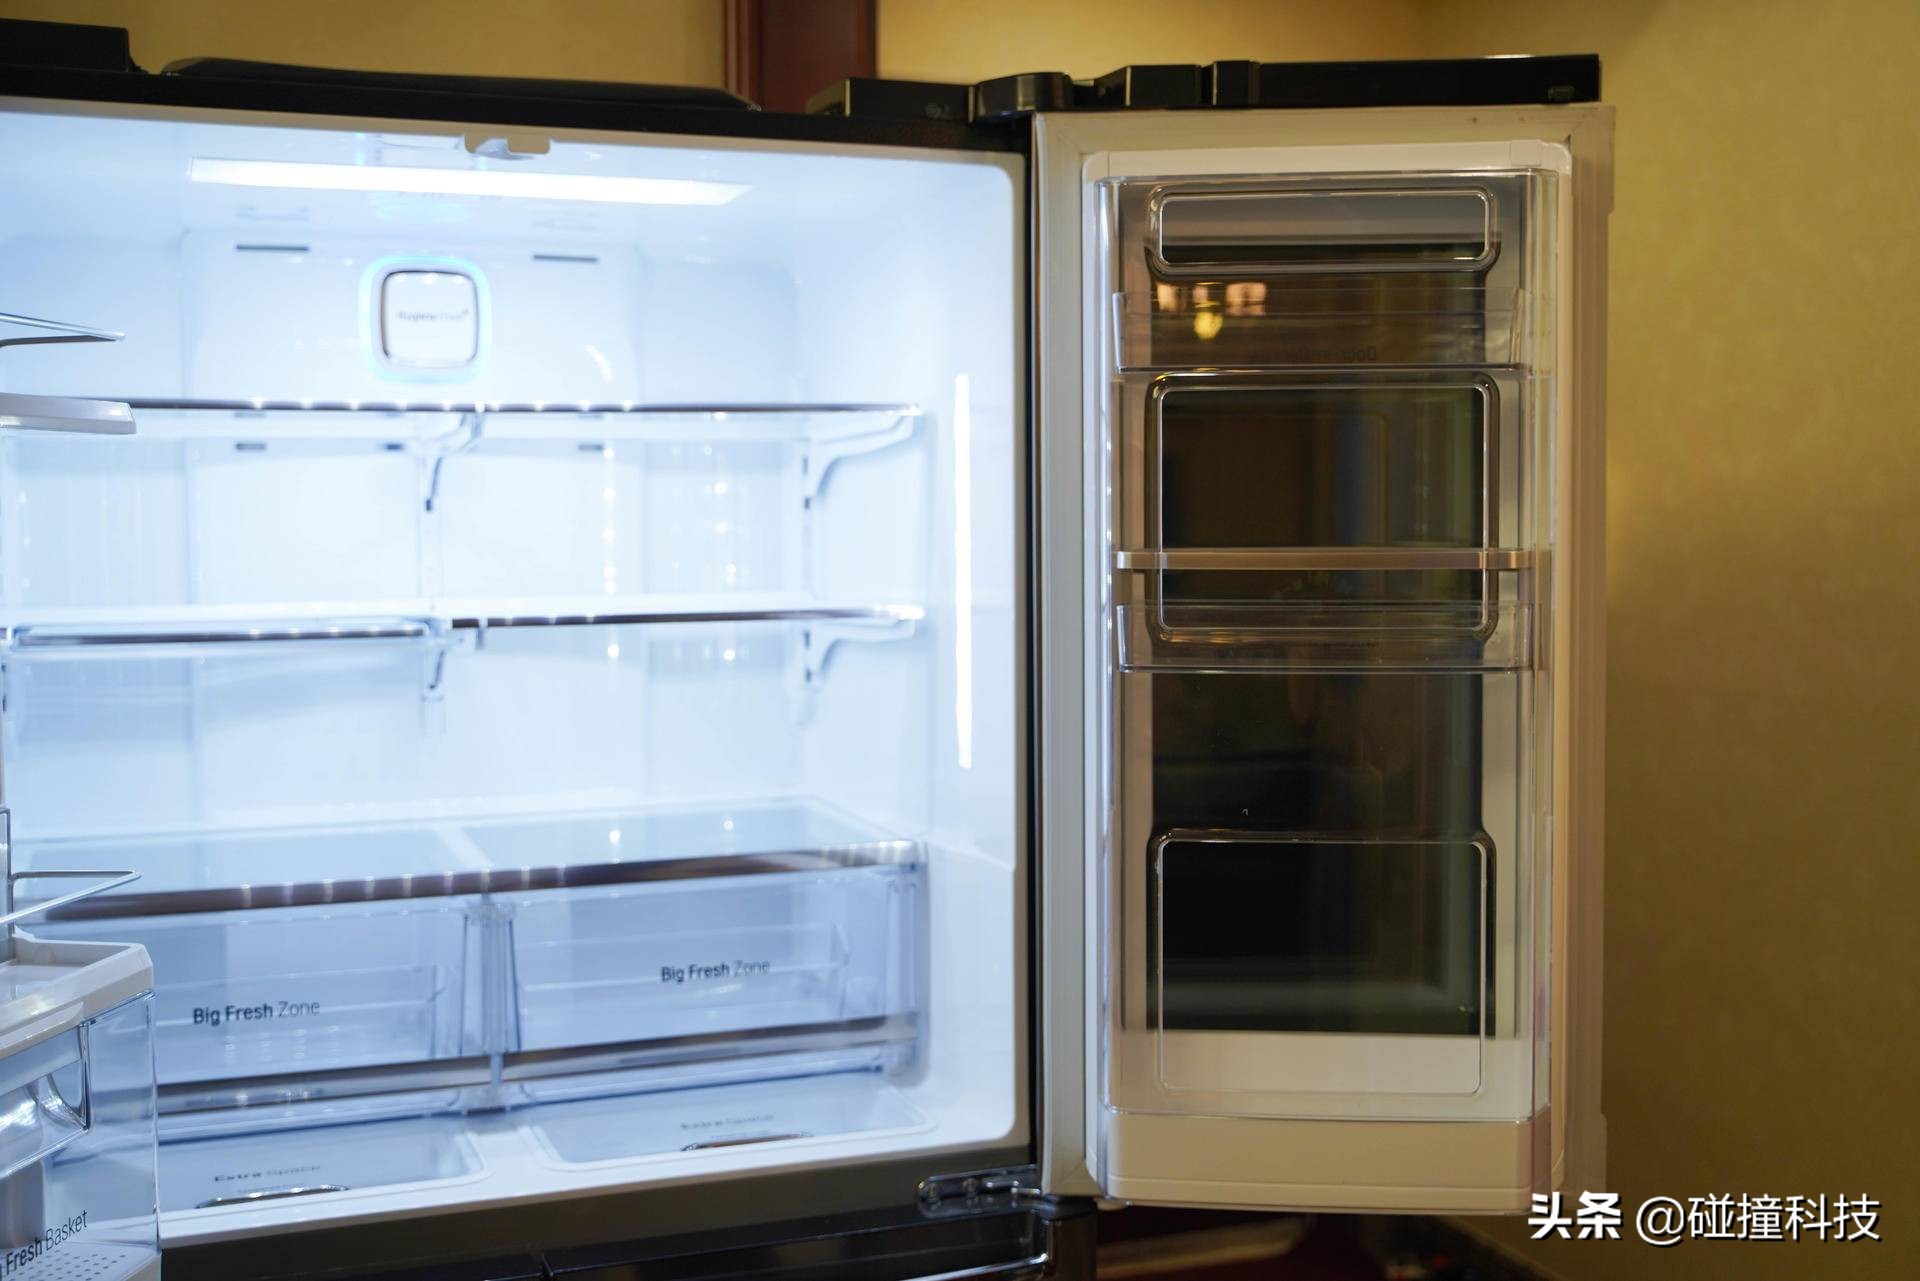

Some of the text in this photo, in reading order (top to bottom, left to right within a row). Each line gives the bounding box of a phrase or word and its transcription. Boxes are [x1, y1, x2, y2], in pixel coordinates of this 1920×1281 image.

[661, 960, 770, 984] Big Fresh Zone
[193, 1000, 320, 1026] Big Fresh Zone
[6, 1237, 42, 1276] Fresh
[46, 1209, 87, 1251] Basket
